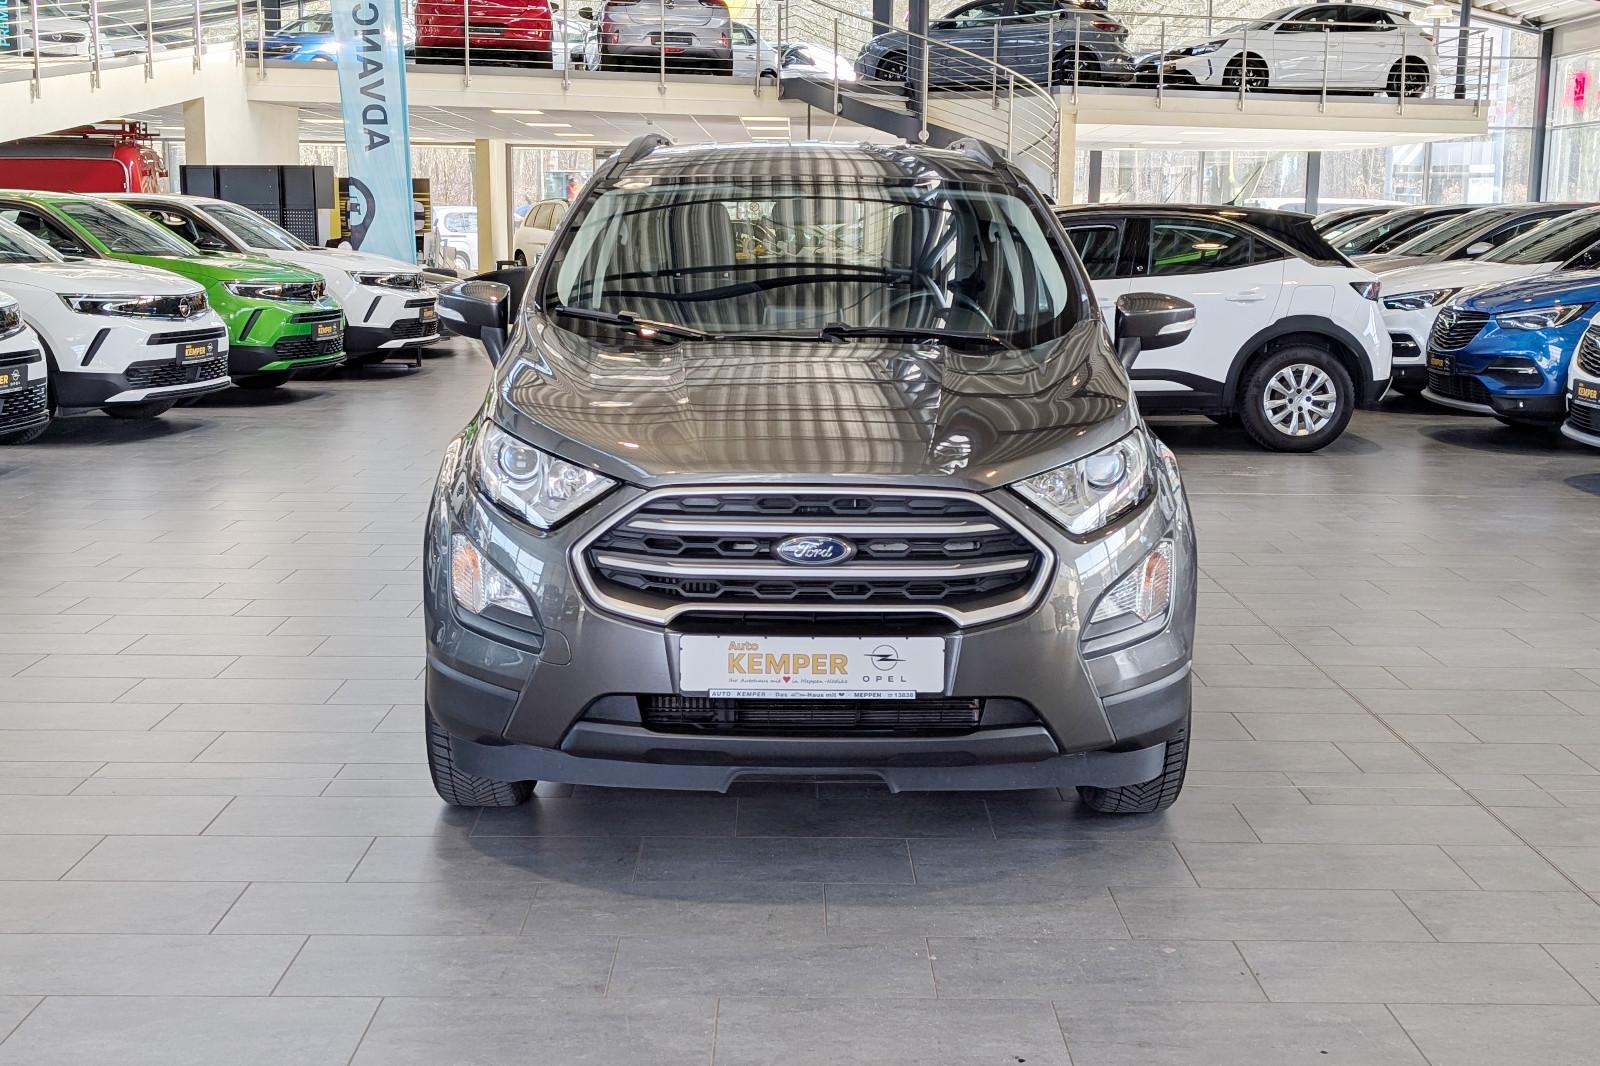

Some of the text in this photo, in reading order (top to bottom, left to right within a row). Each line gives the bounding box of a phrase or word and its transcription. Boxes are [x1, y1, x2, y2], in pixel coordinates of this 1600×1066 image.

[794, 540, 833, 558] Ford
[728, 641, 759, 651] Auto
[727, 653, 848, 675] KEMPER
[862, 675, 907, 683] OPEL
